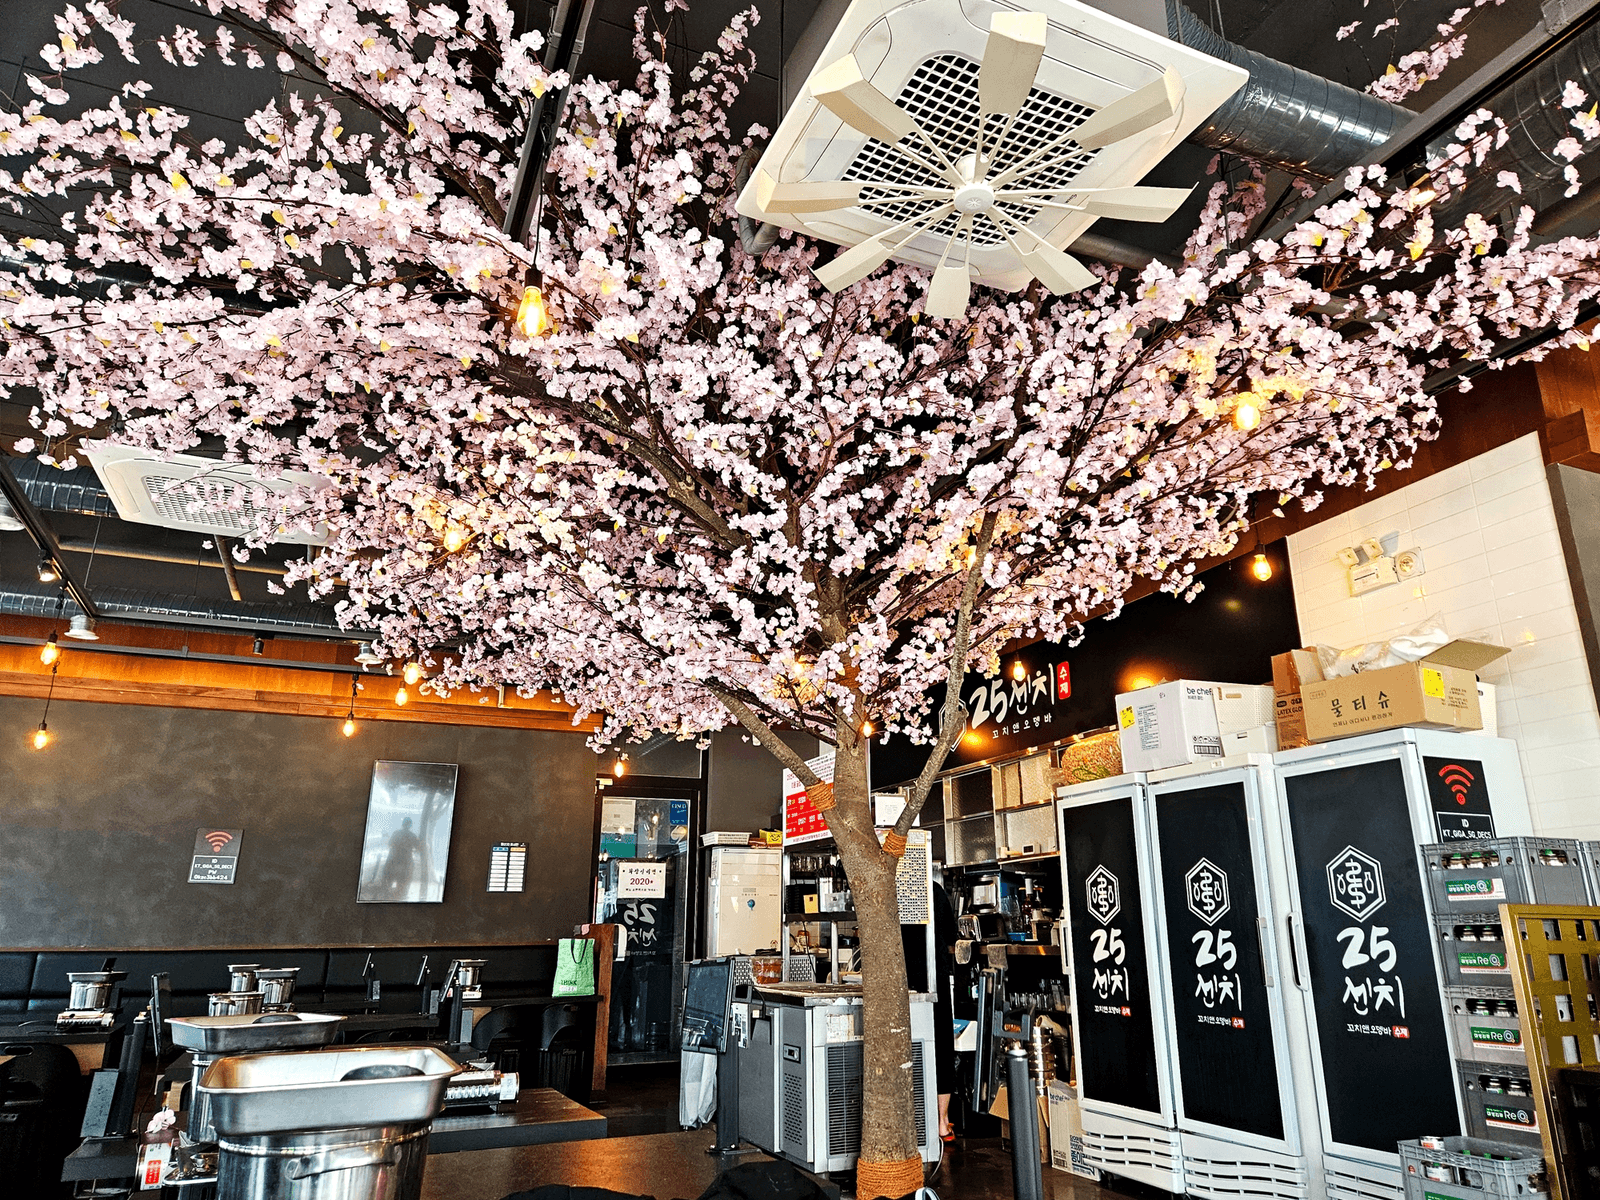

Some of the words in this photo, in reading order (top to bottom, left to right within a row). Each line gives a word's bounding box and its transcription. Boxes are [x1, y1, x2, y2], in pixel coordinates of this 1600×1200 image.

[1059, 666, 1069, 694] 수제
[1331, 691, 1390, 718] 물티슈
[1461, 819, 1469, 828] ID
[1090, 928, 1126, 965] 25
[1192, 929, 1237, 970] 25
[1337, 925, 1397, 972] 25
[1092, 967, 1130, 1001] 센치
[1195, 973, 1242, 1012] 센치
[1342, 975, 1406, 1019] 센치
[1346, 1023, 1392, 1036] 꼬치앤오뎅바
[1394, 1026, 1409, 1038] 수제
